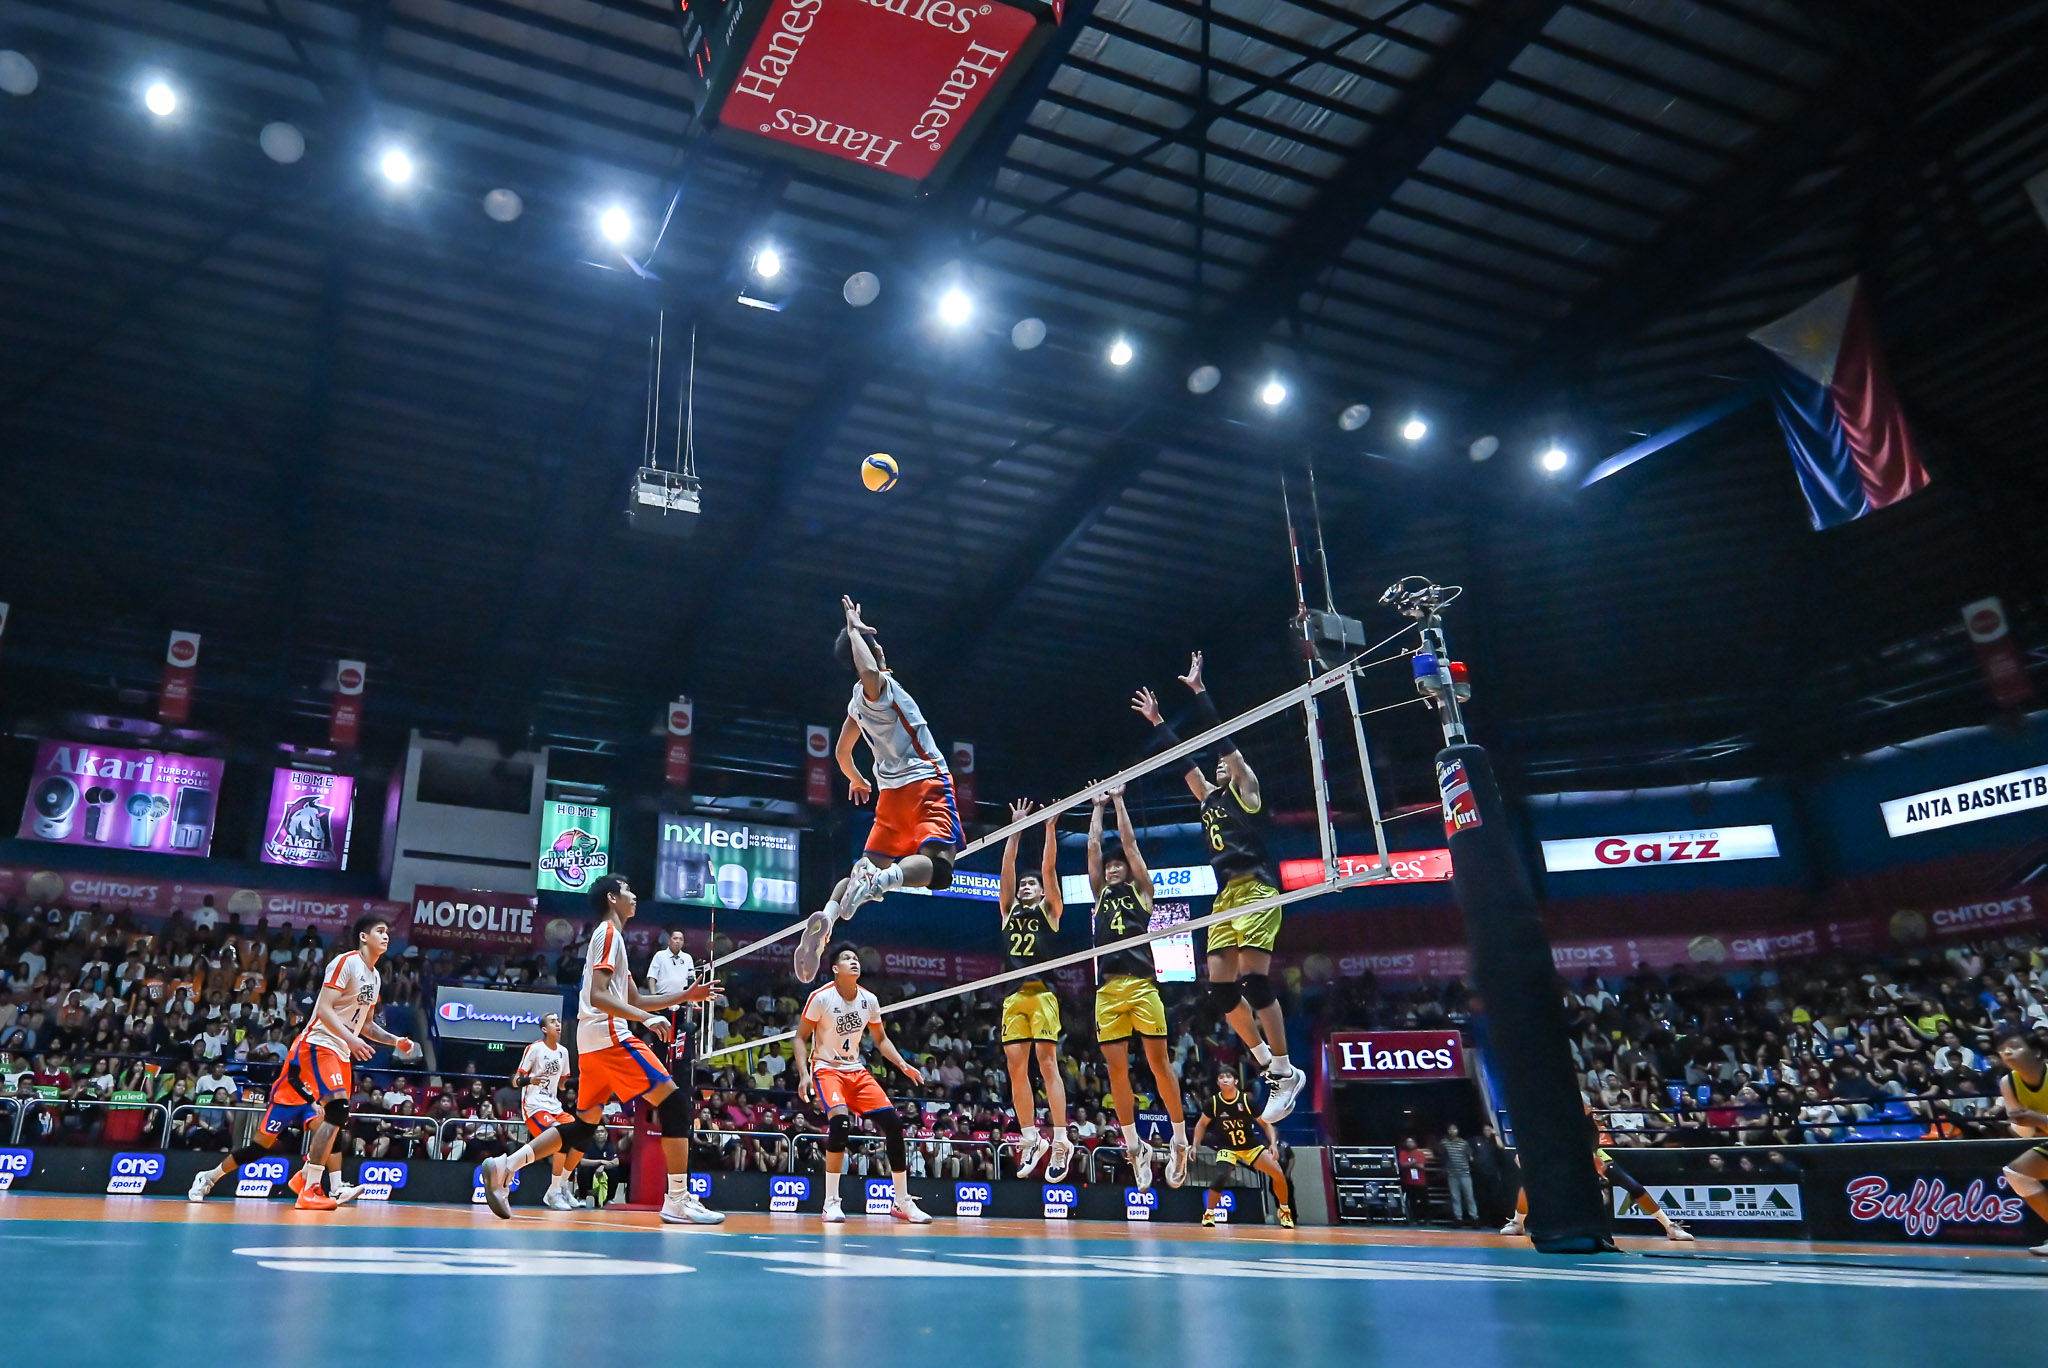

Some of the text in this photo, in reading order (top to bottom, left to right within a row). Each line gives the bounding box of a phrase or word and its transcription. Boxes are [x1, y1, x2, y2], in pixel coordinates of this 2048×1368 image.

[47, 746, 155, 783] Akari
[158, 766, 208, 778] TURBO FAN
[156, 775, 210, 786] AIR COOLER
[291, 772, 334, 788] HOME
[557, 804, 597, 818] HOME
[1906, 797, 1953, 824] ANTA
[282, 835, 324, 849] Akari
[664, 822, 749, 850] nxled
[1210, 825, 1225, 851] 6
[1668, 832, 1719, 842] PETRO
[548, 848, 582, 858] nxled
[1594, 838, 1720, 865] Gazz
[541, 856, 605, 869] CHAMELEONS
[268, 899, 350, 918] CHITOK'S
[414, 899, 533, 934] MOTOLITE
[1110, 911, 1126, 935] 4
[1010, 933, 1036, 957] 22
[885, 953, 946, 971] CHITOK'S
[842, 1038, 850, 1052] 4
[330, 1073, 344, 1086] 19
[832, 1091, 839, 1102] 4
[543, 1115, 552, 1123] 2
[1139, 1113, 1168, 1121] RINGSIDE
[267, 1119, 282, 1132] 22
[1222, 1119, 1244, 1130] SVG
[1228, 1129, 1247, 1146] 13
[1220, 1150, 1229, 1158] 13
[117, 1158, 159, 1174] one
[244, 1162, 284, 1179] one
[364, 1166, 403, 1182] one
[112, 1180, 142, 1189] sports
[240, 1184, 268, 1192] sports
[690, 1178, 707, 1193] ne
[774, 1181, 805, 1195] one
[959, 1186, 988, 1200] one
[1046, 1188, 1074, 1202] one
[1128, 1190, 1154, 1205] one
[1657, 1187, 1794, 1210] ALPHA
[773, 1200, 796, 1208] sports
[1218, 1194, 1232, 1207] ne
[1847, 1175, 2024, 1236] Buffalo's
[959, 1204, 980, 1213] sports
[1046, 1206, 1066, 1215] sports
[1129, 1208, 1148, 1217] sports
[1737, 1210, 1779, 1218] COMPANY,
